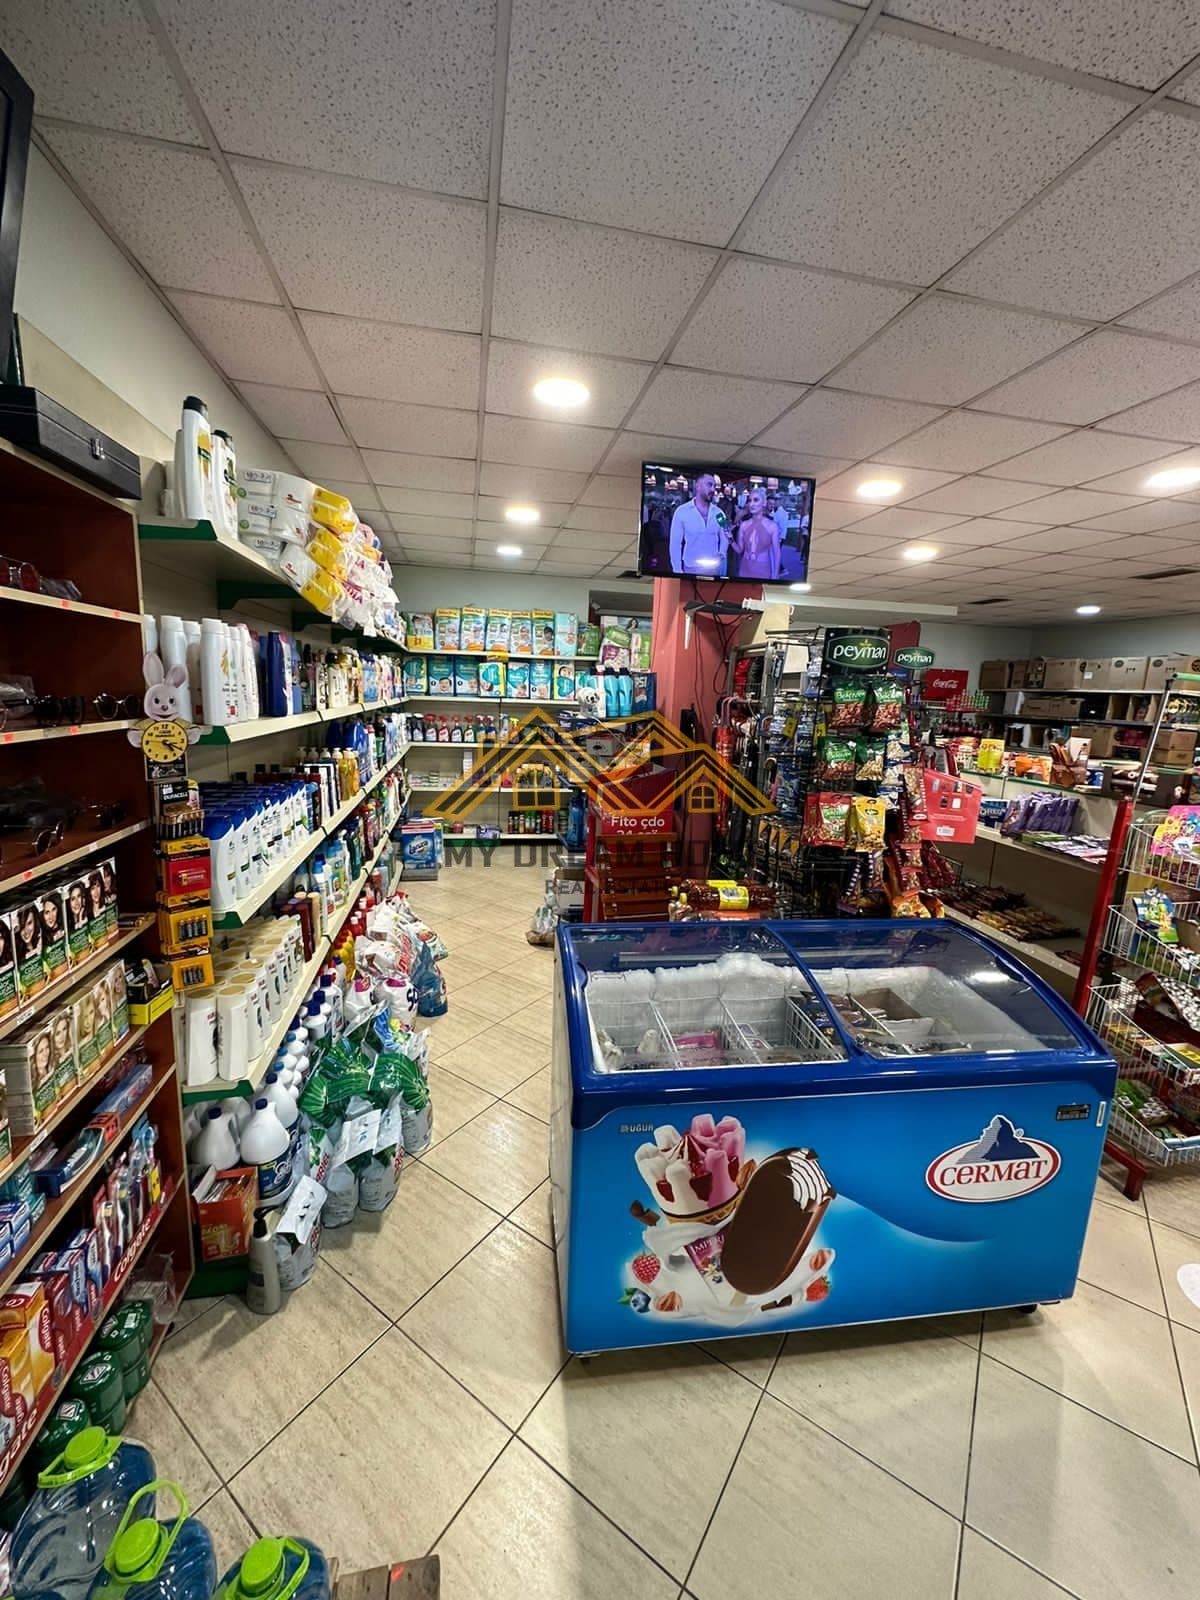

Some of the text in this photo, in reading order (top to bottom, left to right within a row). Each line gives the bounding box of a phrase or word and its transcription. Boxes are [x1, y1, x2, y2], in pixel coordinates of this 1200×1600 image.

[833, 644, 887, 660] peyman
[897, 653, 932, 663] peyman
[611, 815, 665, 830] Fito çdo
[114, 1217, 151, 1282] Colgate
[41, 1307, 53, 1350] Colgate
